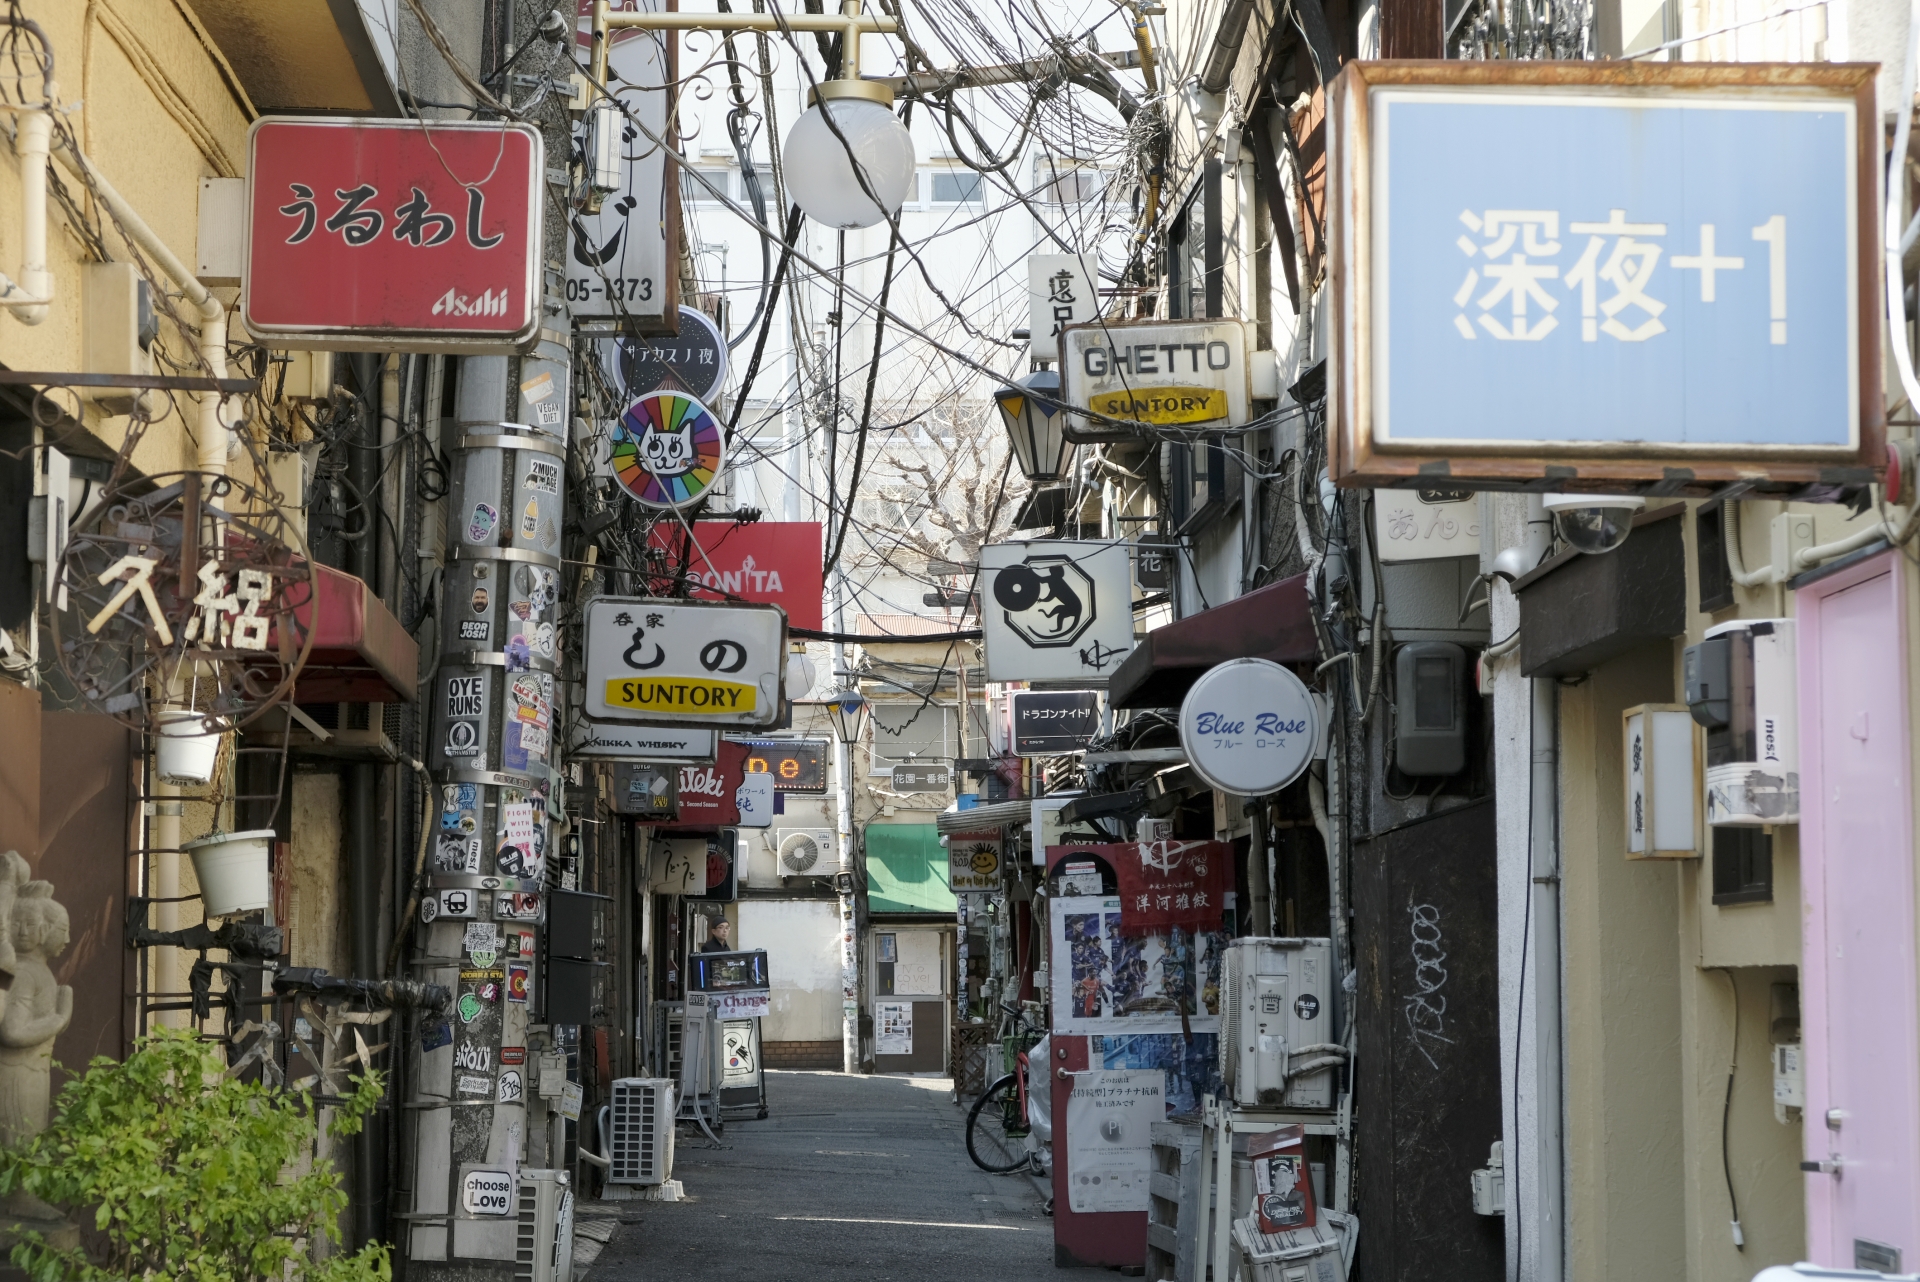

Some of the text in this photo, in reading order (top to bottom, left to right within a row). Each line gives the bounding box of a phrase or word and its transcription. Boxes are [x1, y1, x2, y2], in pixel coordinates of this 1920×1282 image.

[279, 183, 504, 250] うるわし
[431, 286, 508, 317] Asahi
[1048, 269, 1076, 338] 遠足
[1084, 340, 1231, 377] GHETTO
[537, 402, 559, 414] VEGAN
[1106, 396, 1211, 415] SUNTORY
[543, 413, 557, 424] DIET
[532, 461, 558, 479] 2MUCH
[685, 564, 784, 594] BONITA
[461, 621, 488, 631] BEOR
[612, 611, 665, 629] 呑家
[459, 629, 487, 639] JOSH
[449, 677, 482, 697] OYE
[622, 682, 743, 708] SUNTORY
[449, 695, 482, 717] RUNS
[1195, 711, 1306, 736] Blue Rose
[592, 739, 688, 750] NIKKA WHISKY
[1213, 738, 1286, 749] ブルー ローズ
[894, 772, 948, 785] 花園一番街
[507, 809, 532, 817] FIGHT
[687, 800, 703, 808] Second
[510, 830, 531, 838] LOVE
[466, 1178, 510, 1192] choose
